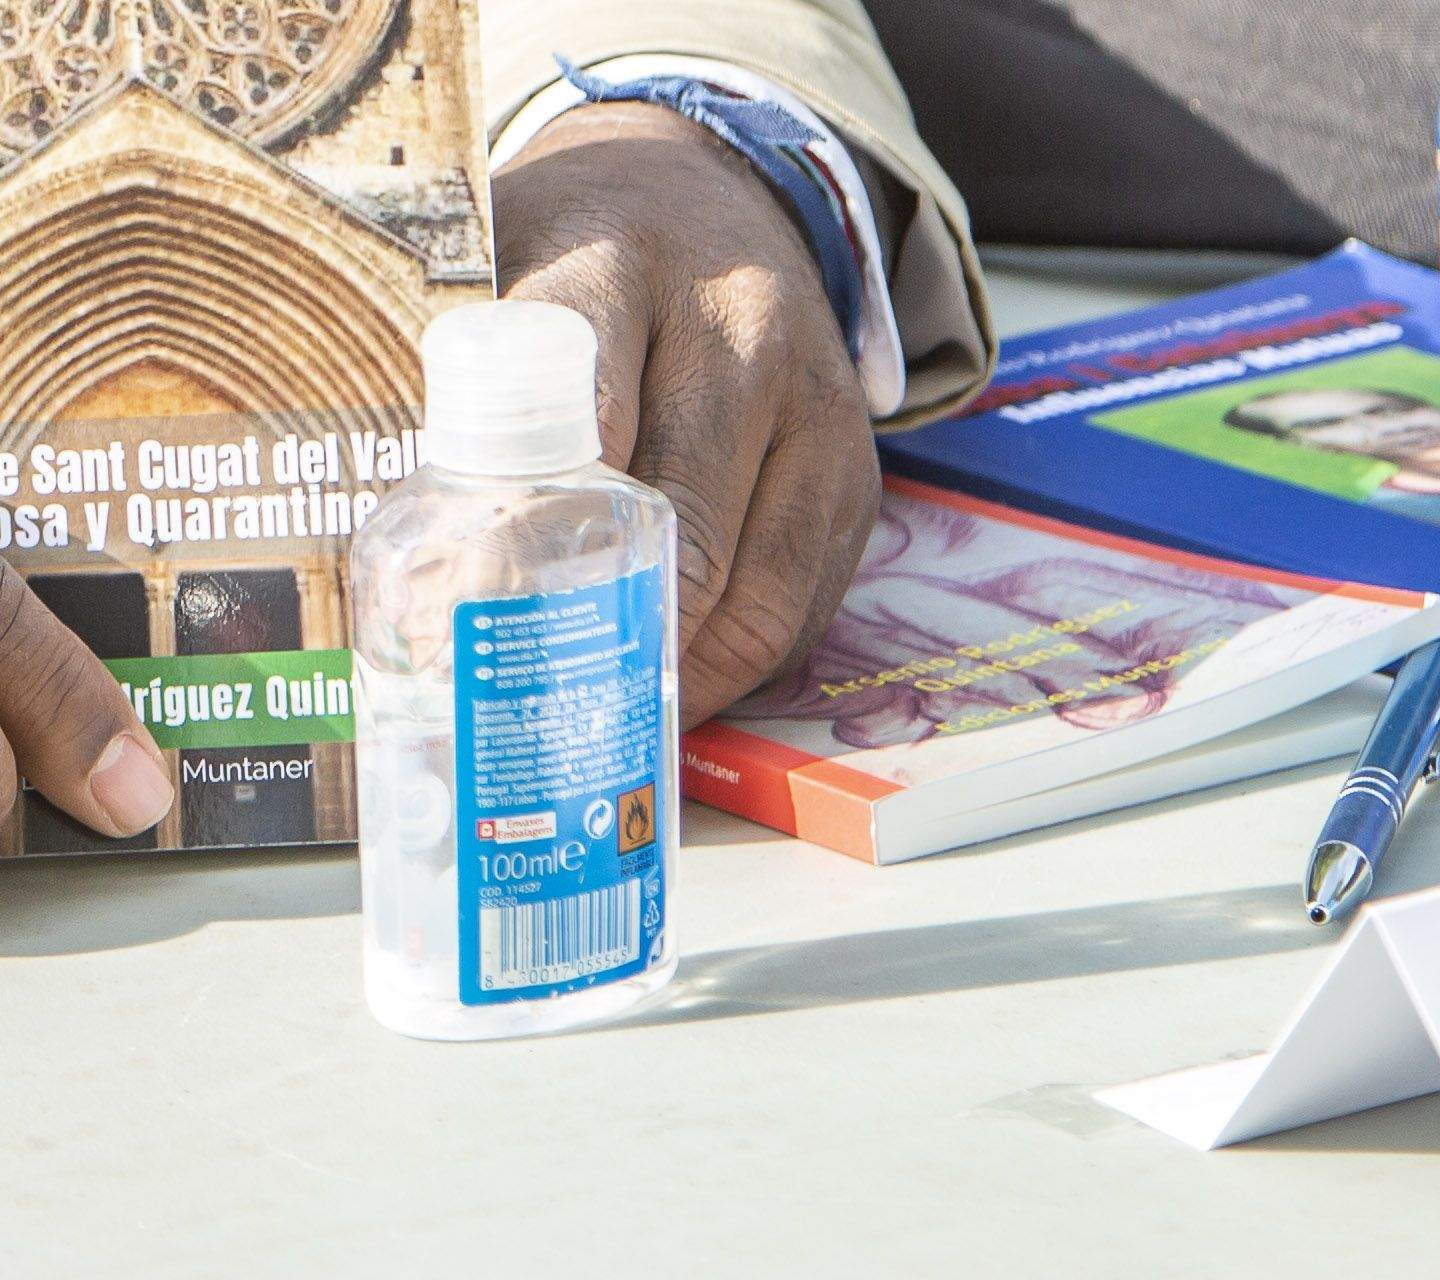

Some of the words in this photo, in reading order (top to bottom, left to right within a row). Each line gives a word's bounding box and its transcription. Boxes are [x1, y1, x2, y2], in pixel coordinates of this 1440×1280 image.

[31, 441, 127, 494] Sant
[138, 434, 263, 493] Cugat
[272, 432, 339, 486] del
[349, 428, 425, 481] Vall
[86, 501, 110, 552] y
[126, 485, 380, 548] Quarantine
[121, 676, 254, 727] ríguez
[265, 671, 357, 720] Quin
[820, 655, 958, 699] Arsenio
[182, 756, 314, 785] Muntaner
